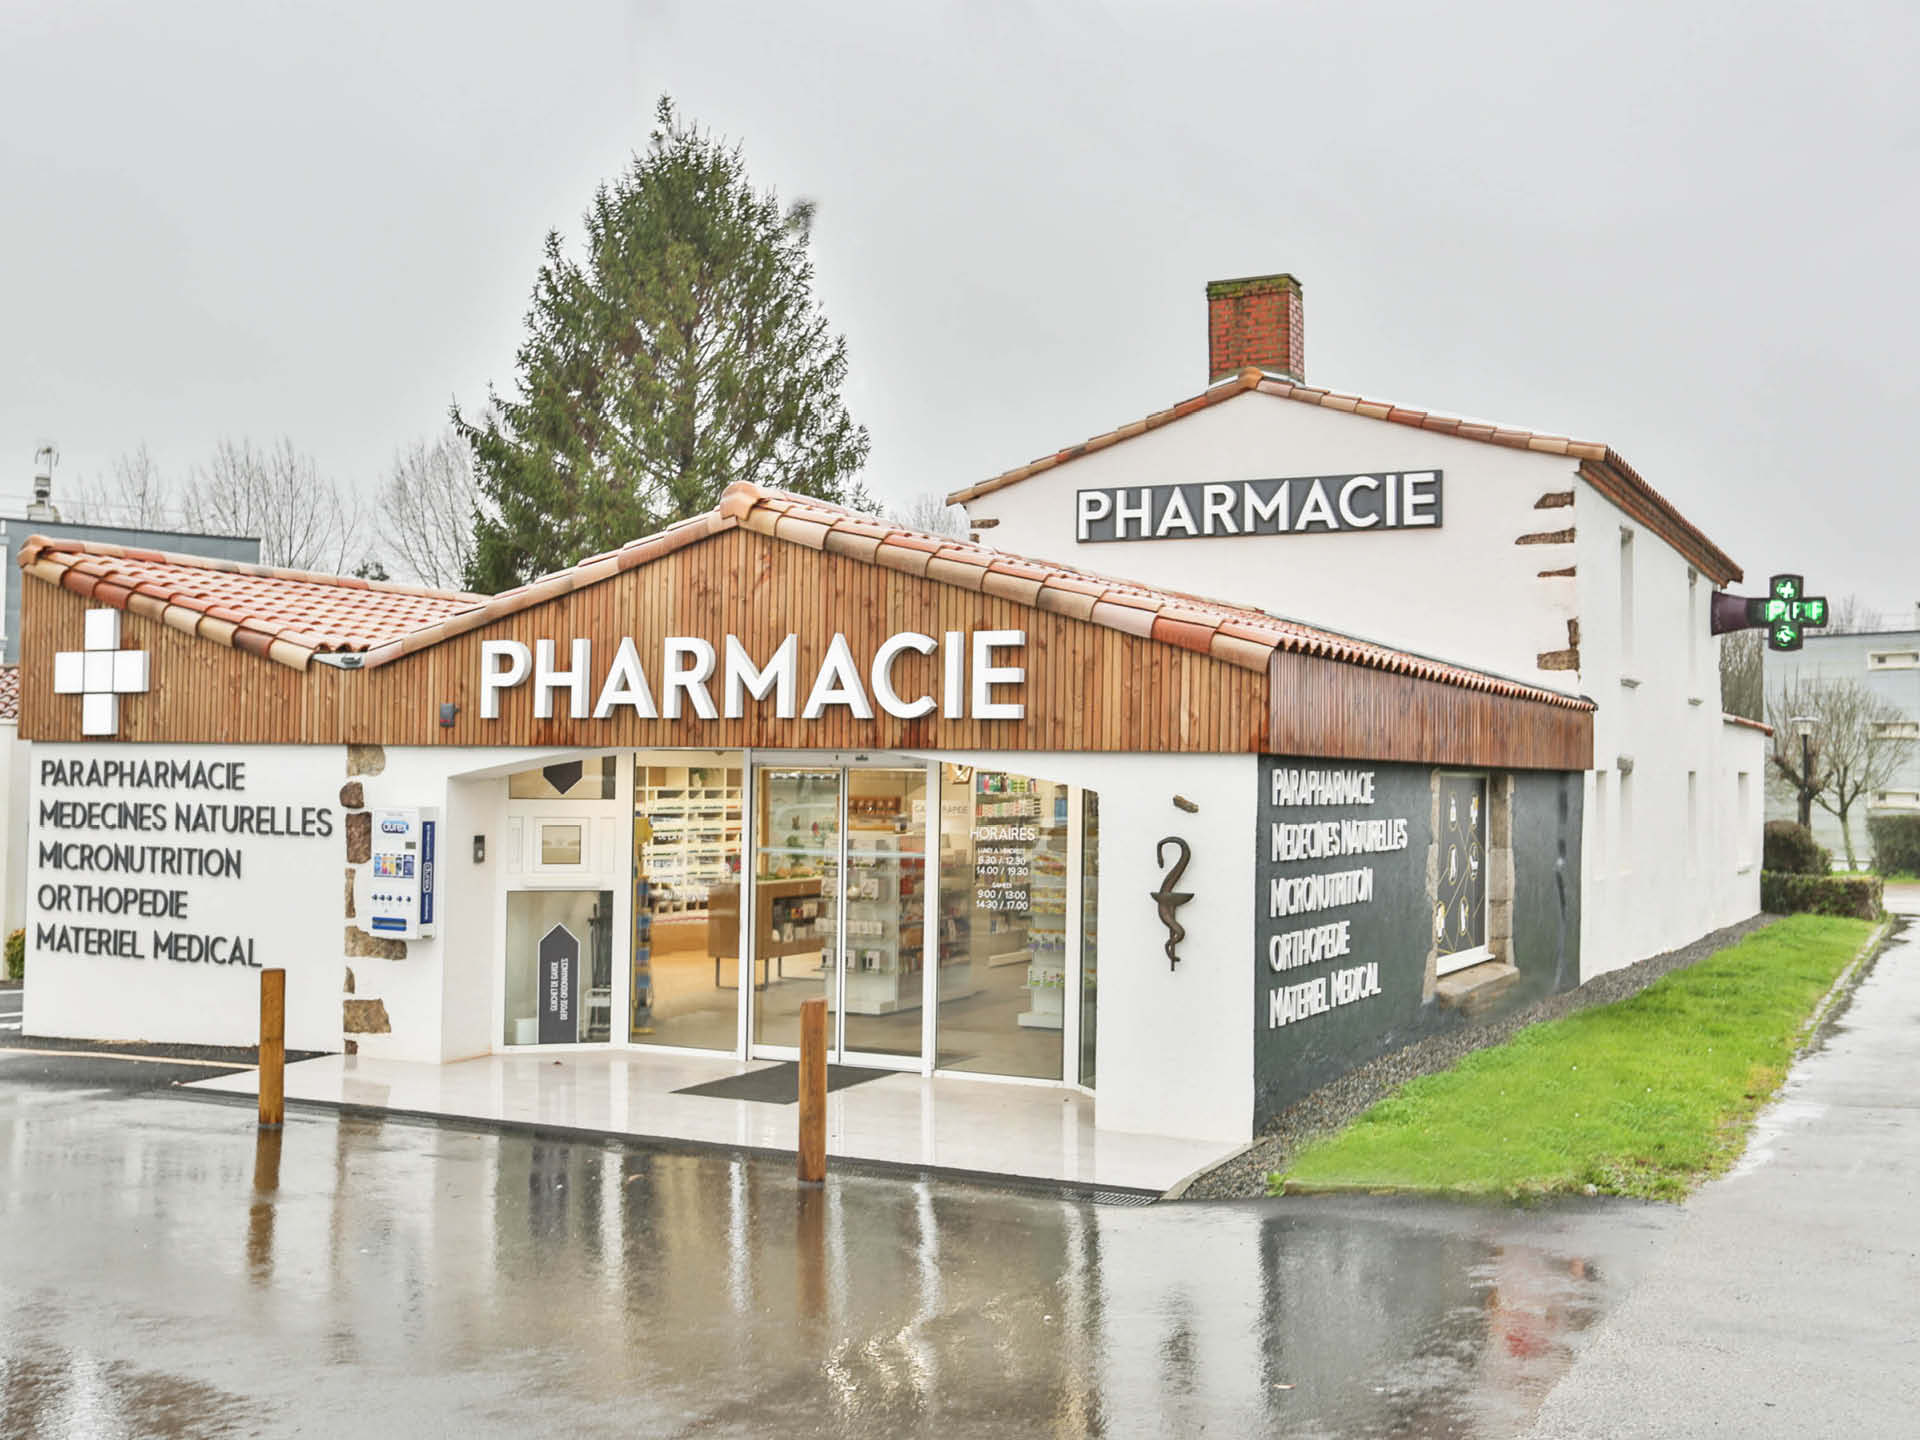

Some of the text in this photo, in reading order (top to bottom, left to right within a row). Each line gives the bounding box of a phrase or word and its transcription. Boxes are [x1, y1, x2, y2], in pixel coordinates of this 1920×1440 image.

[1078, 471, 1436, 541] PHARMACIE
[480, 629, 1026, 721] PHARMACIE
[40, 758, 246, 791] PARAPHARMACIE
[1272, 768, 1375, 806] PARAPHARMACIE
[39, 799, 333, 838] MEDECINES NATURELLES
[970, 826, 1036, 841] HORAIRES
[1272, 817, 1408, 862] MEDECINES NATURELLES
[38, 840, 242, 879] MICRONUTRITION
[37, 884, 188, 919] ORTHOPEDIE
[1270, 867, 1373, 918] MICRONUTRITION
[36, 923, 263, 968] MATERIEL MEDICAL
[1269, 921, 1351, 973] ORTHOPEDIE
[1269, 962, 1382, 1029] MATERIEL MEDICAL
